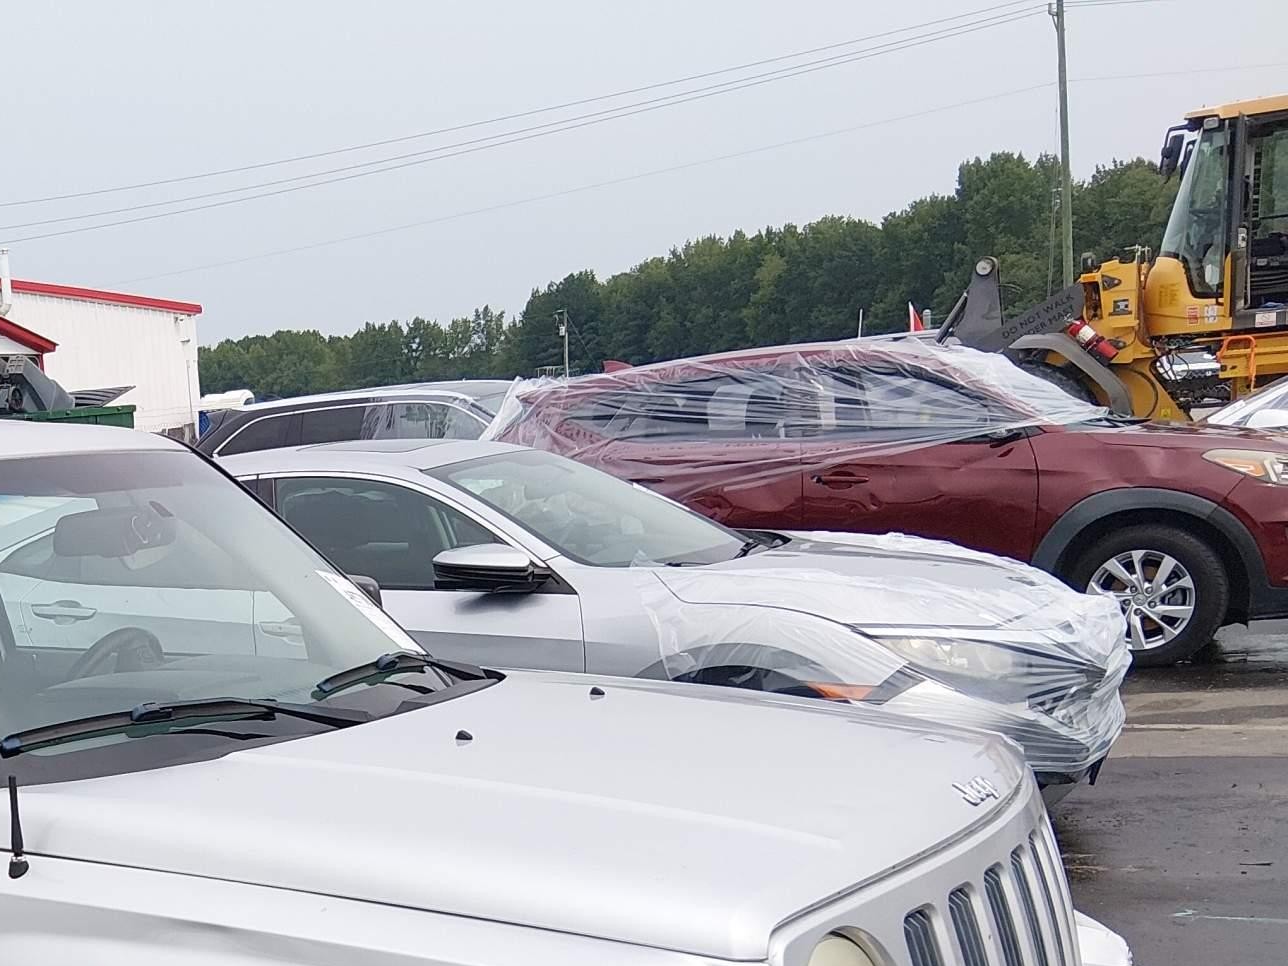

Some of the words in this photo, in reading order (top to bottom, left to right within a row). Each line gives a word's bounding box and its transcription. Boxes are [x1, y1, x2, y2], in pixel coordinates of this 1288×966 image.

[1003, 326, 1018, 339] DO
[1019, 312, 1042, 329] NOT
[1043, 293, 1075, 313] WALK
